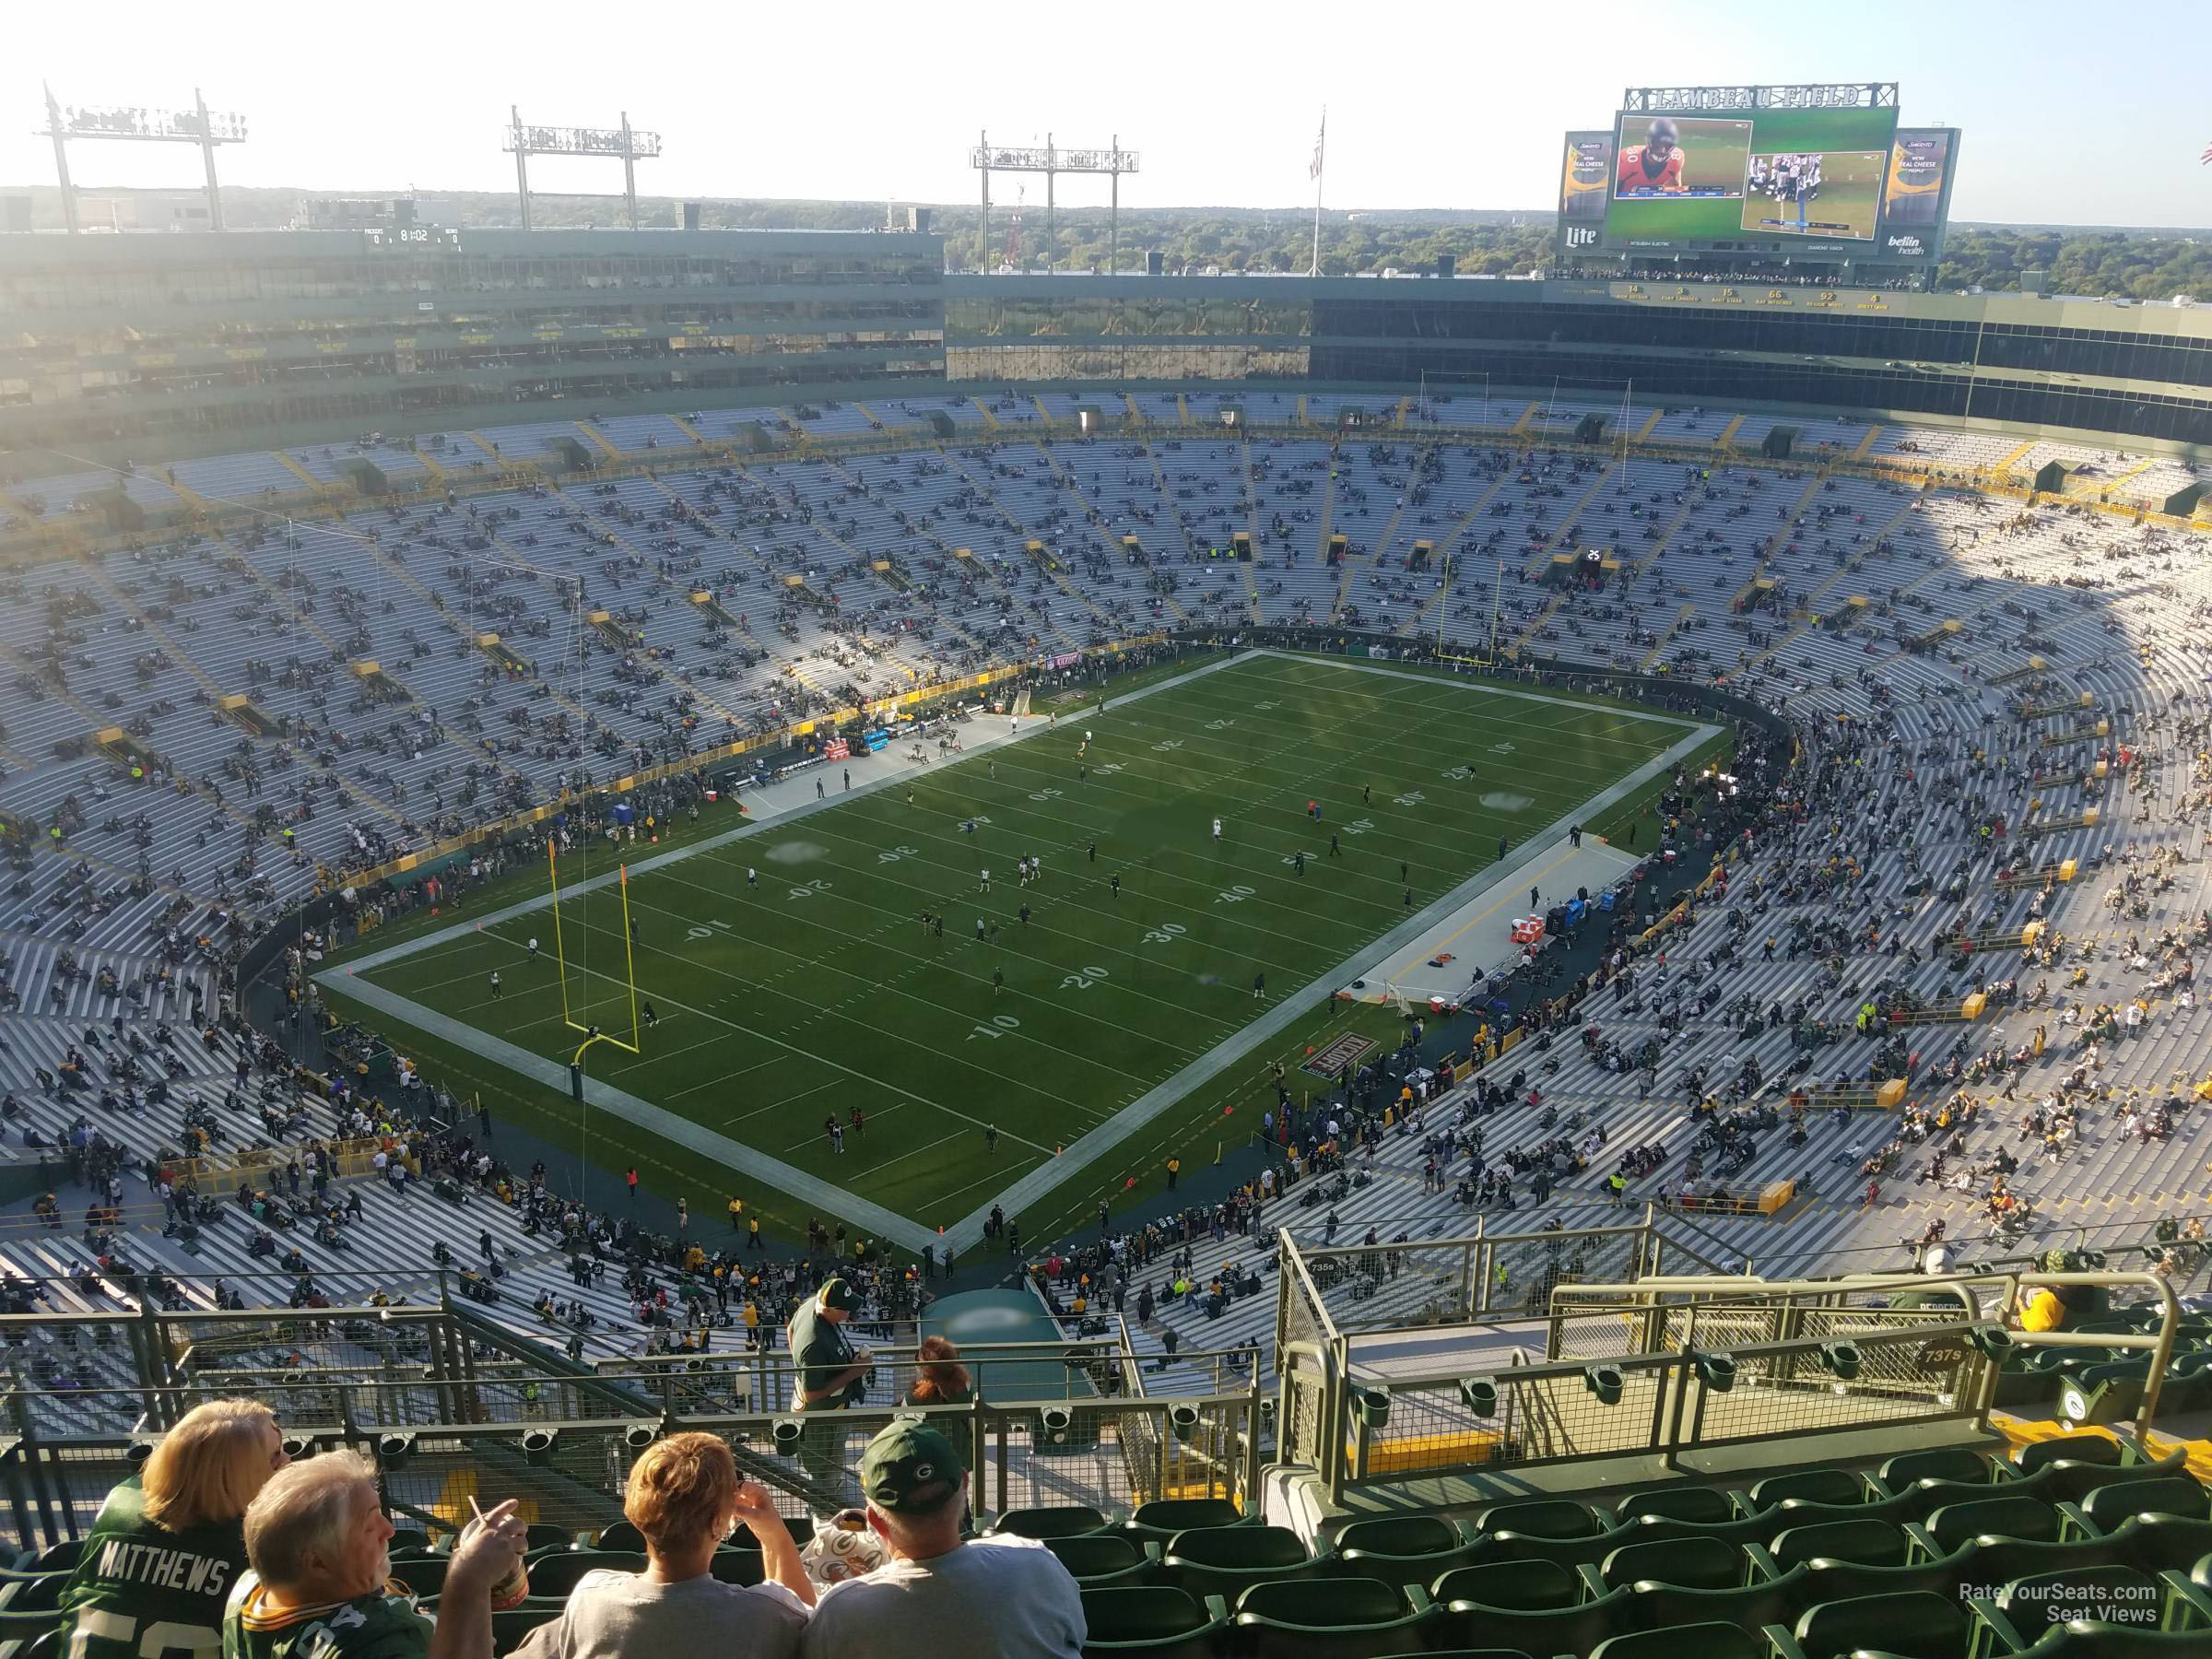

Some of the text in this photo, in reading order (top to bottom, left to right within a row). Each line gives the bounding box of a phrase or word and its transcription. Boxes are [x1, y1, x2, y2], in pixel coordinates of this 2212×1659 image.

[1655, 86, 1859, 109] LAMBEAU FIELD
[373, 235, 380, 244] 0
[400, 229, 428, 241] 81:02
[453, 234, 458, 243] 0
[1565, 227, 1596, 248] Lite
[1888, 236, 1920, 246] bellin
[1898, 246, 1924, 255] health
[1723, 288, 1733, 296] 15
[1769, 289, 1782, 299] 66
[1820, 292, 1834, 300] 92
[1254, 701, 1280, 711] 10
[1205, 719, 1235, 730] 20
[1151, 740, 1182, 752] 30
[1487, 743, 1515, 755] 10
[1092, 763, 1124, 775] 40
[1029, 787, 1065, 802] 50
[1393, 791, 1426, 806] 30
[1342, 819, 1374, 835] 40
[878, 845, 919, 862] 30
[789, 879, 833, 898] 20
[1219, 885, 1256, 903] 40
[688, 920, 733, 938] 10
[1146, 924, 1187, 943] 30
[1063, 966, 1110, 989] 20
[973, 1015, 1020, 1039] 10
[1316, 1036, 1371, 1071] KICKOFF
[97, 1540, 229, 1597] MATTHEWS
